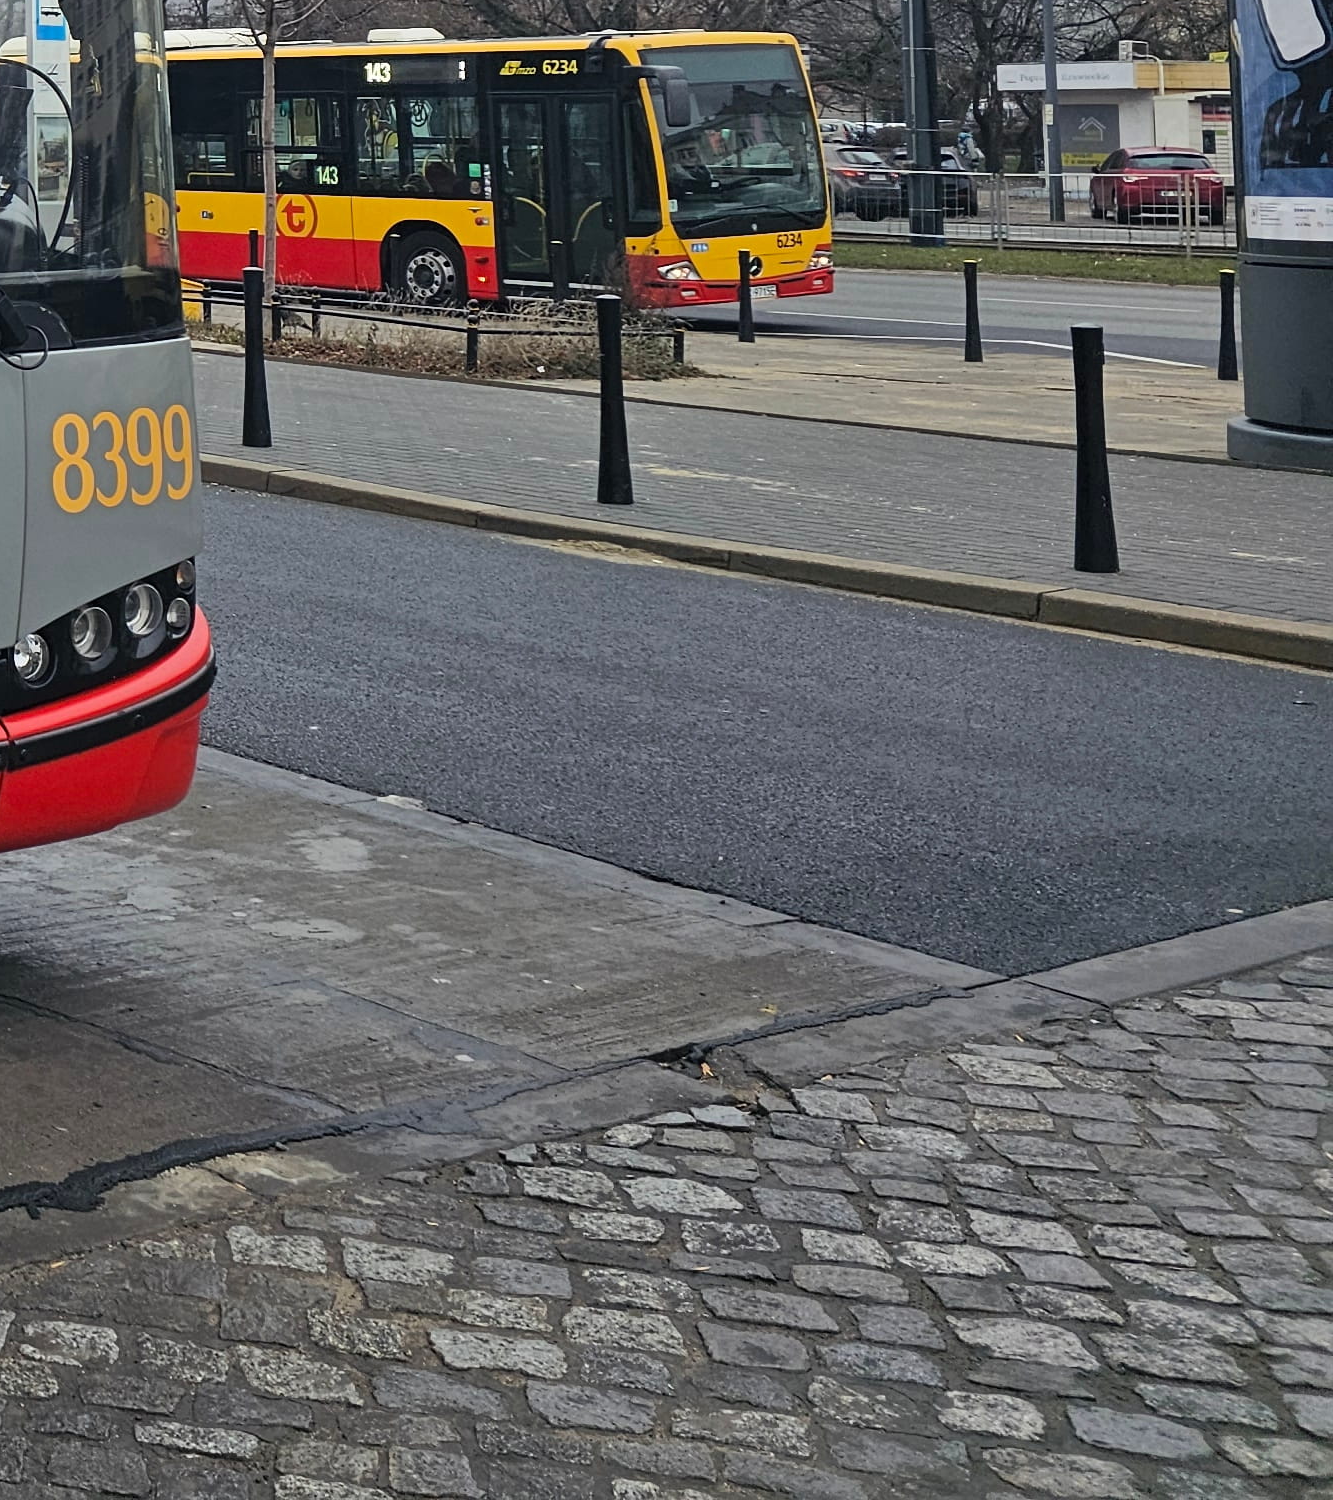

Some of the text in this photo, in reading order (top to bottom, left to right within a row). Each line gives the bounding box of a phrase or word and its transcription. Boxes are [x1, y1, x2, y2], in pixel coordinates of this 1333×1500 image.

[364, 63, 391, 82] 143
[542, 59, 578, 75] 6234
[317, 166, 339, 185] 143
[777, 233, 802, 248] 6234
[51, 404, 194, 513] 8399
